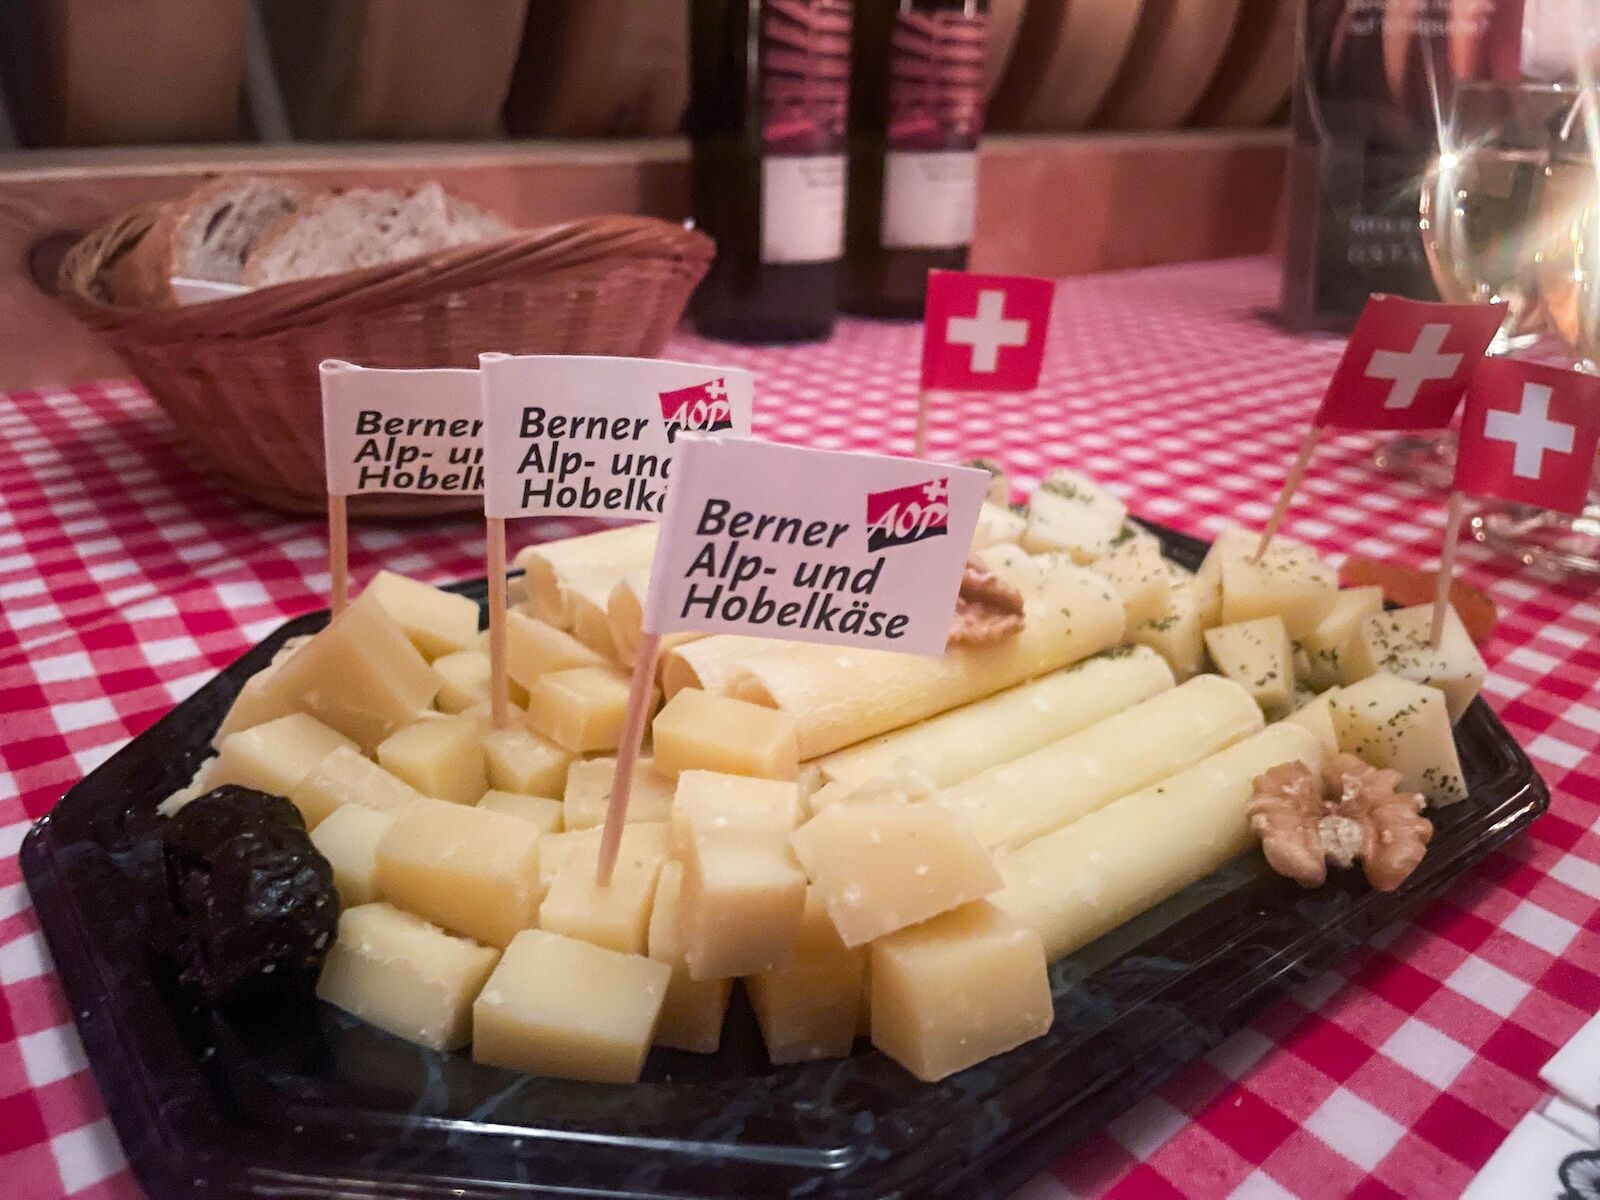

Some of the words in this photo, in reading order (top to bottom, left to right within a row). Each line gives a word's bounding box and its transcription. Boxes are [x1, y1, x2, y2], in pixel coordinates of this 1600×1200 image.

[355, 410, 483, 437] Berner
[519, 406, 649, 441] Berner
[353, 437, 433, 470] Alp-
[517, 441, 595, 484] Alp-
[696, 498, 849, 549] Berner
[866, 501, 948, 539] AOP
[684, 540, 777, 591] Alp-
[793, 557, 886, 595] und
[680, 583, 910, 639] Hobelkäse
